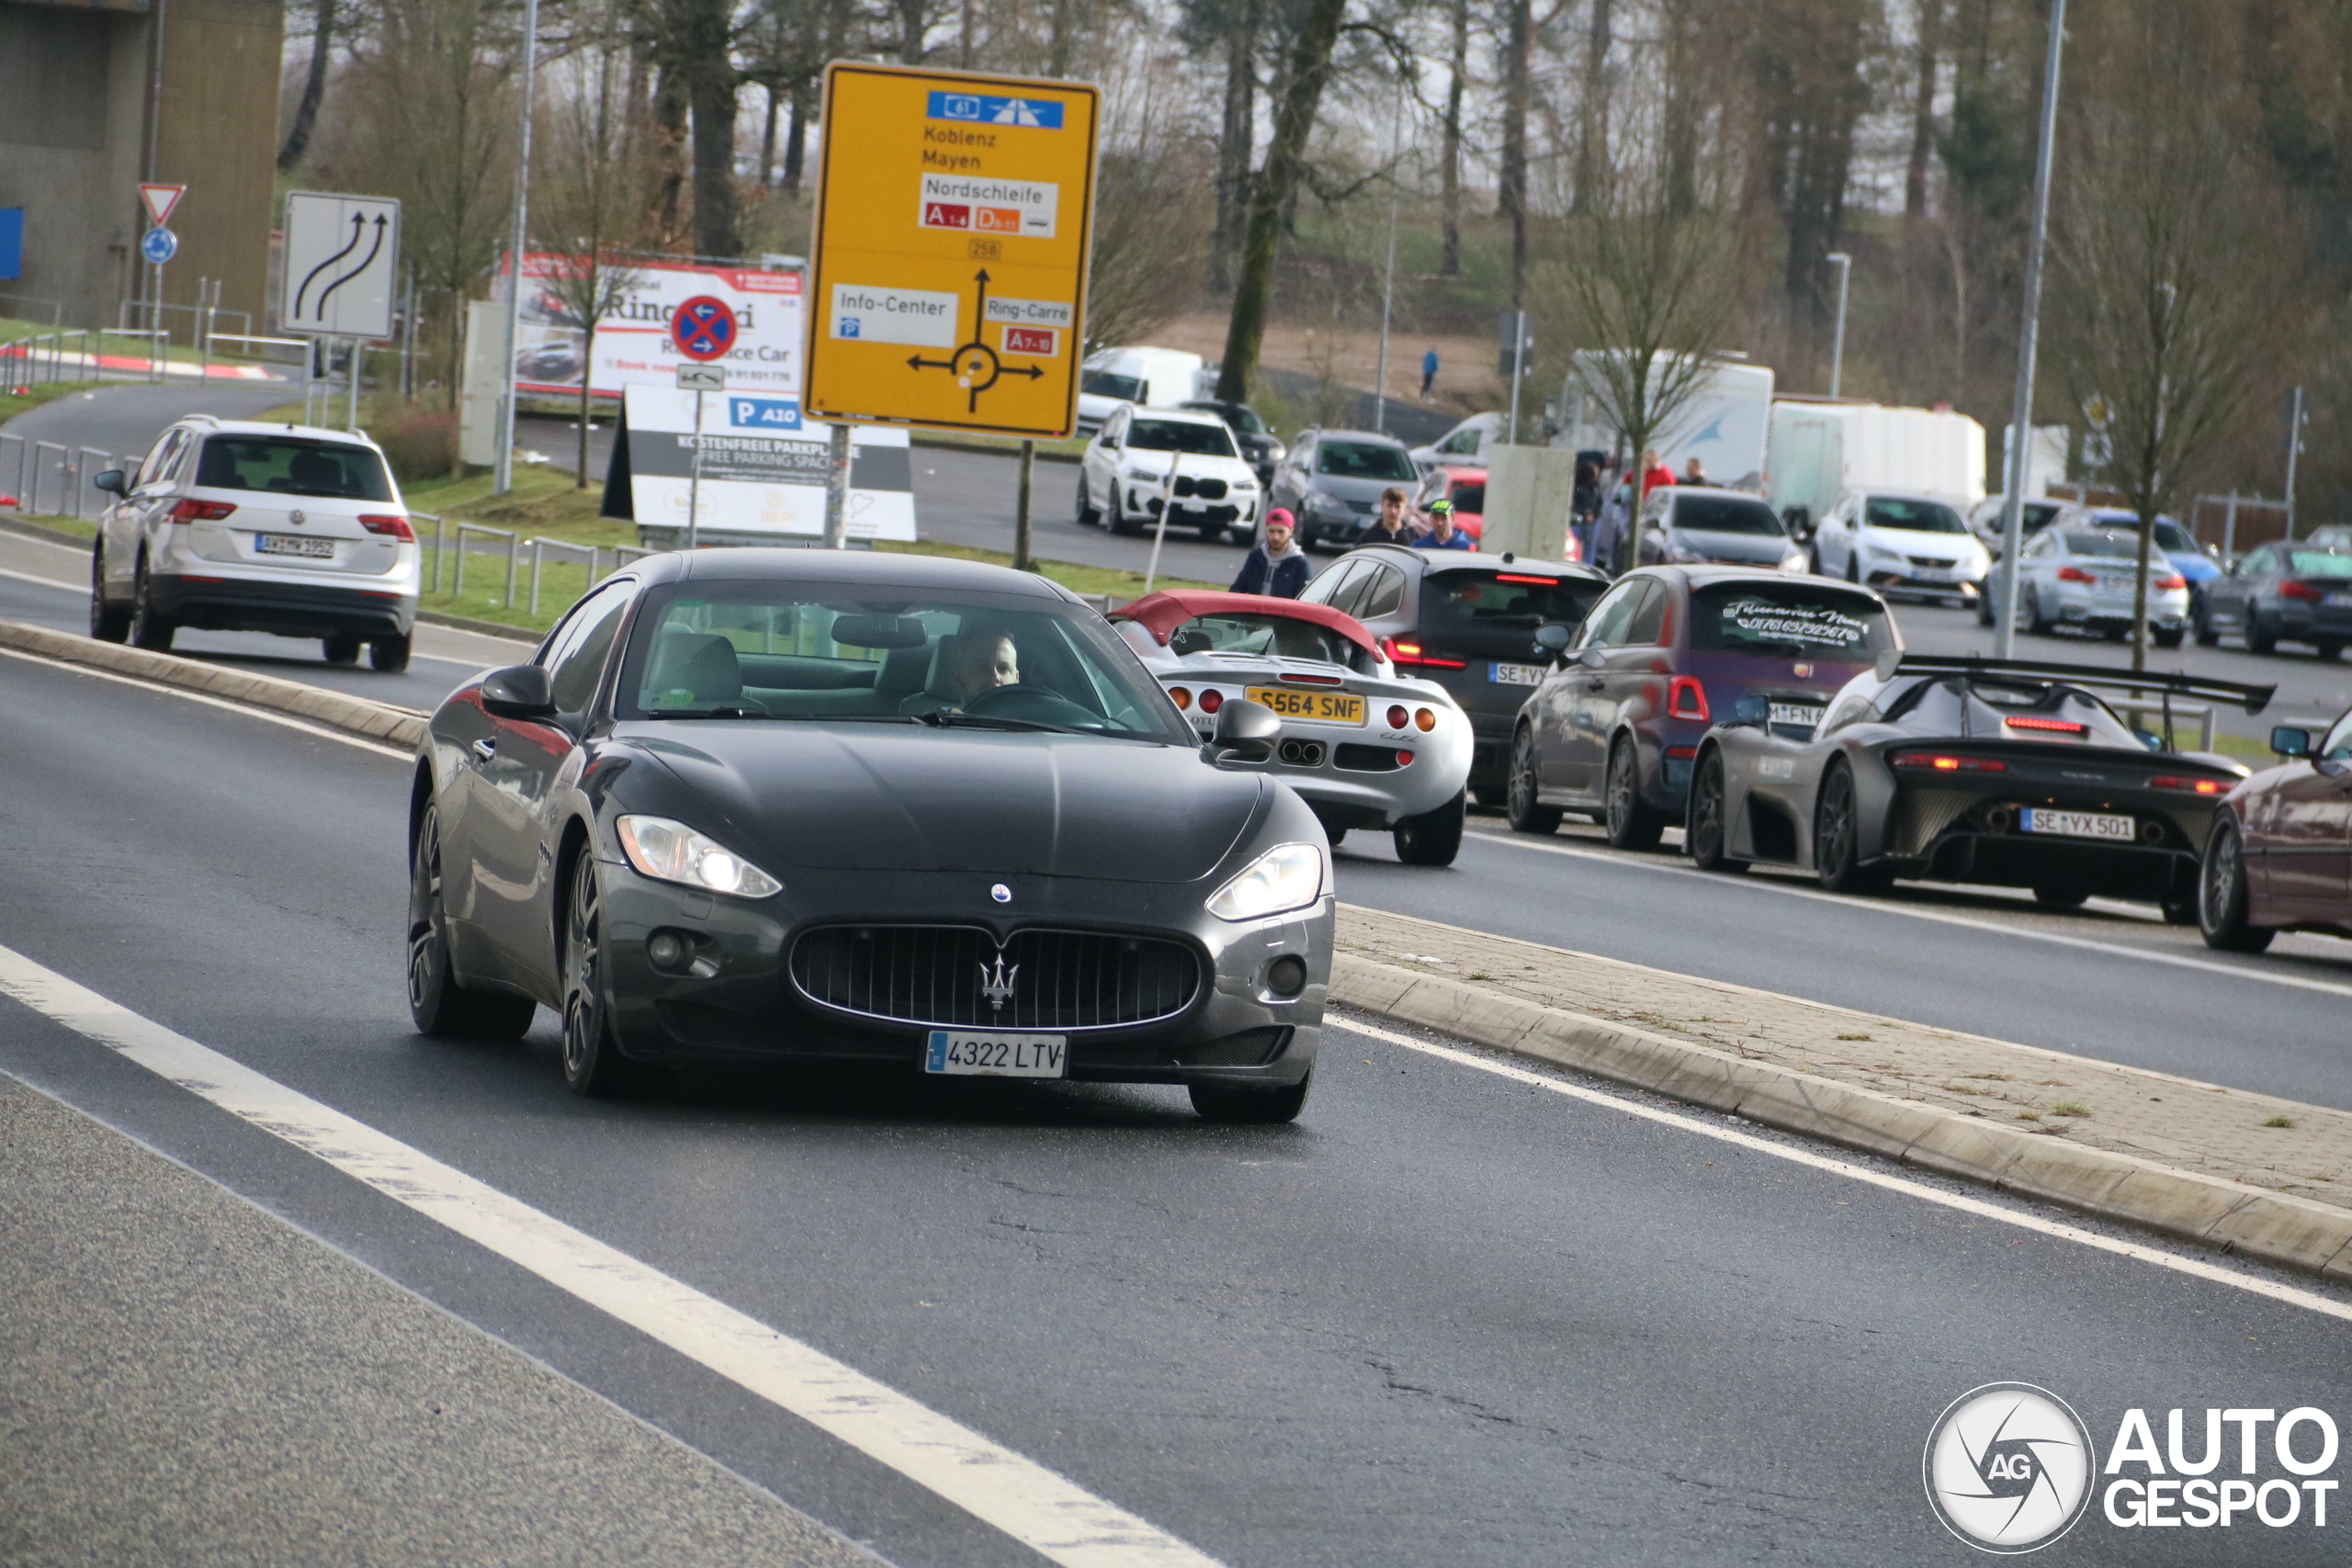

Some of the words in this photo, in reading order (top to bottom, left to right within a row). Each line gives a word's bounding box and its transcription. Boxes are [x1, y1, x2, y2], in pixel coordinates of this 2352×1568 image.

[955, 100, 970, 115] 61
[923, 127, 998, 148] Koblenz
[921, 149, 982, 171] Mayen
[925, 179, 1044, 204] Nordschleife
[971, 243, 998, 258] 258
[841, 293, 947, 316] Info-Center
[987, 300, 1069, 321] Ring-Carré
[758, 346, 790, 363] Car
[761, 407, 797, 423] A10
[700, 449, 732, 464] FREE
[733, 451, 792, 468] PARKING
[1498, 666, 1518, 682] SE
[1261, 692, 1315, 715] S564
[1320, 697, 1361, 719] SNF
[1790, 706, 1811, 722] FN
[2033, 812, 2057, 830] SE
[2097, 818, 2131, 837] 501
[948, 1041, 1009, 1066] 4322
[1015, 1043, 1061, 1069] LTV
